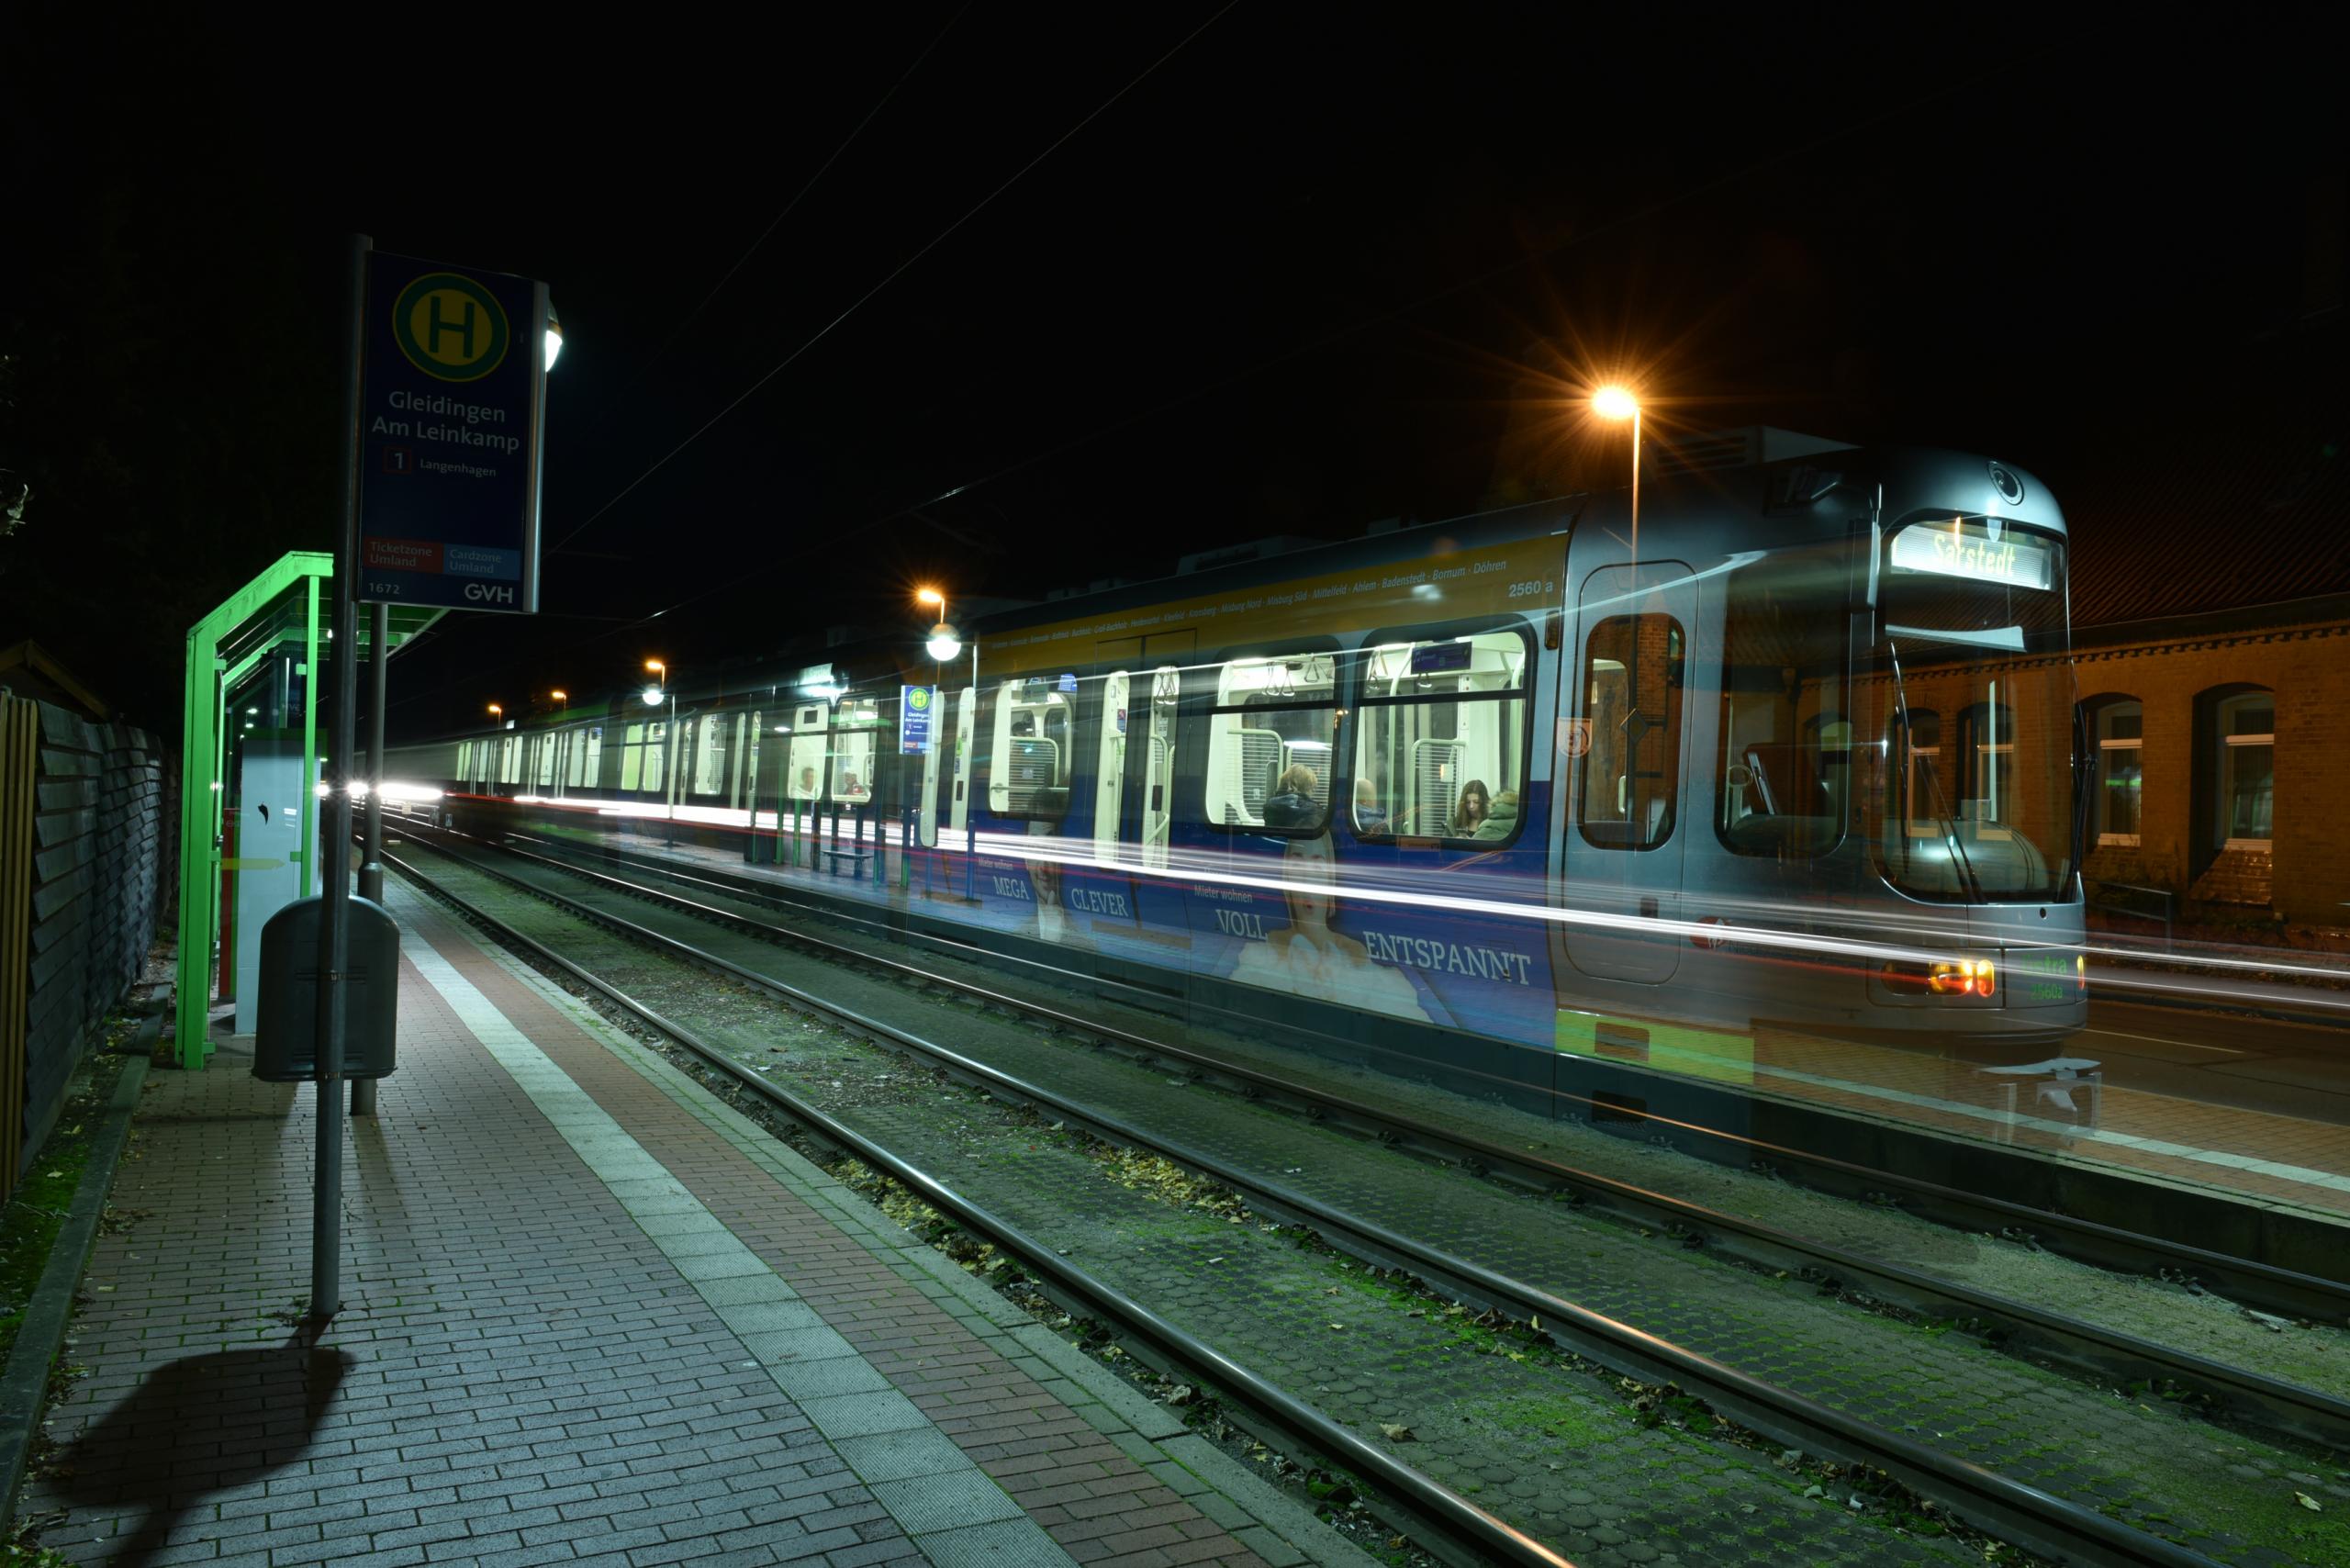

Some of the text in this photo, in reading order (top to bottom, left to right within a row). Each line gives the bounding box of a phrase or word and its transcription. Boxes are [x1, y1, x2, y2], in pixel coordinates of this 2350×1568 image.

[429, 296, 475, 358] H
[388, 390, 505, 424] Gleidingen
[372, 416, 520, 455] Am Leinkamp
[394, 452, 497, 477] 1 Langenhagen
[369, 553, 416, 567] Umland
[370, 541, 432, 556] Ticketzone
[449, 549, 502, 564] Cardzone
[1934, 533, 2014, 577] Sarstedt
[449, 559, 494, 574] Umland
[368, 582, 401, 595] 1672
[464, 583, 513, 604] GVH
[1268, 595, 1292, 606] Misburg
[1294, 589, 1307, 602] Süd
[1313, 585, 1347, 599] Mittelfeld
[1352, 581, 1376, 593] Ahlem
[1382, 573, 1426, 588] Badenstedt
[1433, 567, 1465, 581] Bornum
[1474, 560, 1506, 574] Döhren
[1509, 580, 1553, 597] 2560 a
[993, 876, 1128, 916] MEGA CLEVER
[1194, 885, 1252, 903] Mieter wohnen
[1214, 908, 1531, 985] VOLL ENTSPANNT
